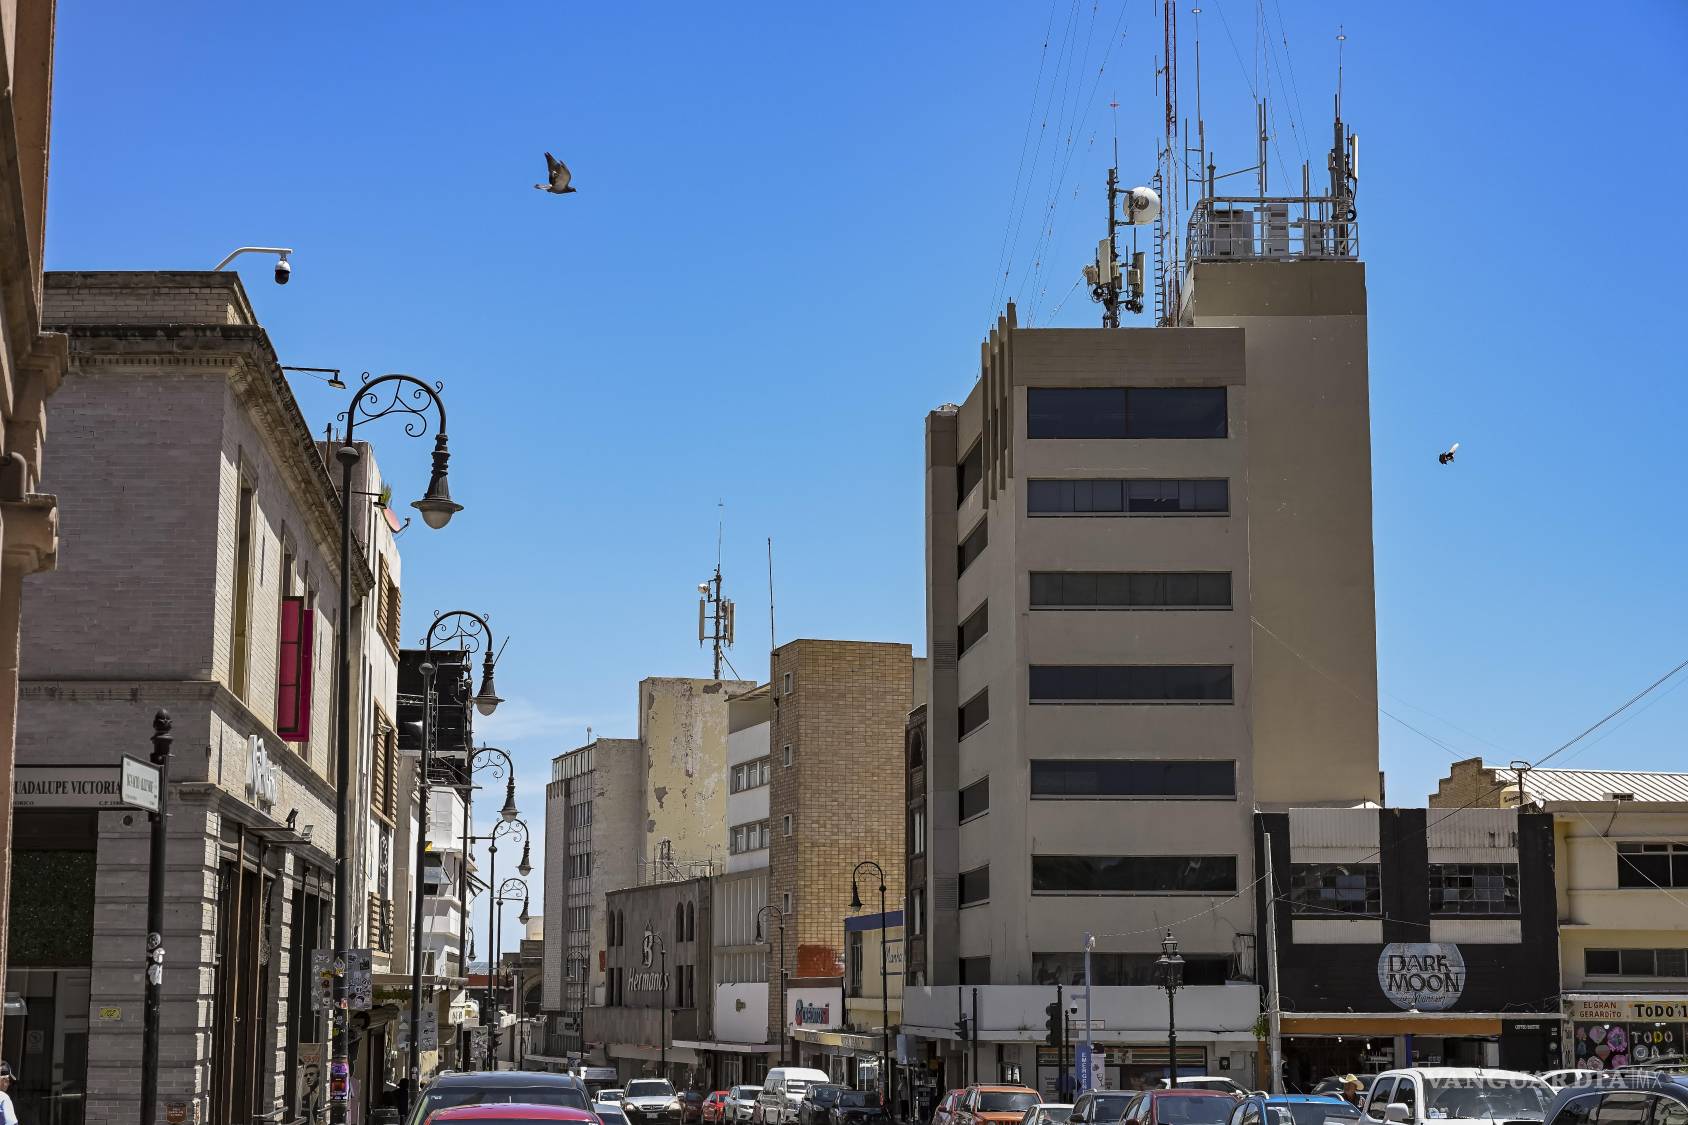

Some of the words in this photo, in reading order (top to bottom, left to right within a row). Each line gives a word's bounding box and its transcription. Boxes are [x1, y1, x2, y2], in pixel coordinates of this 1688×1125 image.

[71, 780, 121, 795] VICTORIA
[1388, 954, 1451, 973] DARK
[628, 967, 670, 992] Hermanos
[1387, 973, 1461, 993] MOON
[1583, 1001, 1592, 1009] EL
[1594, 1001, 1617, 1009] GRAN
[1631, 1031, 1673, 1044] TODO
